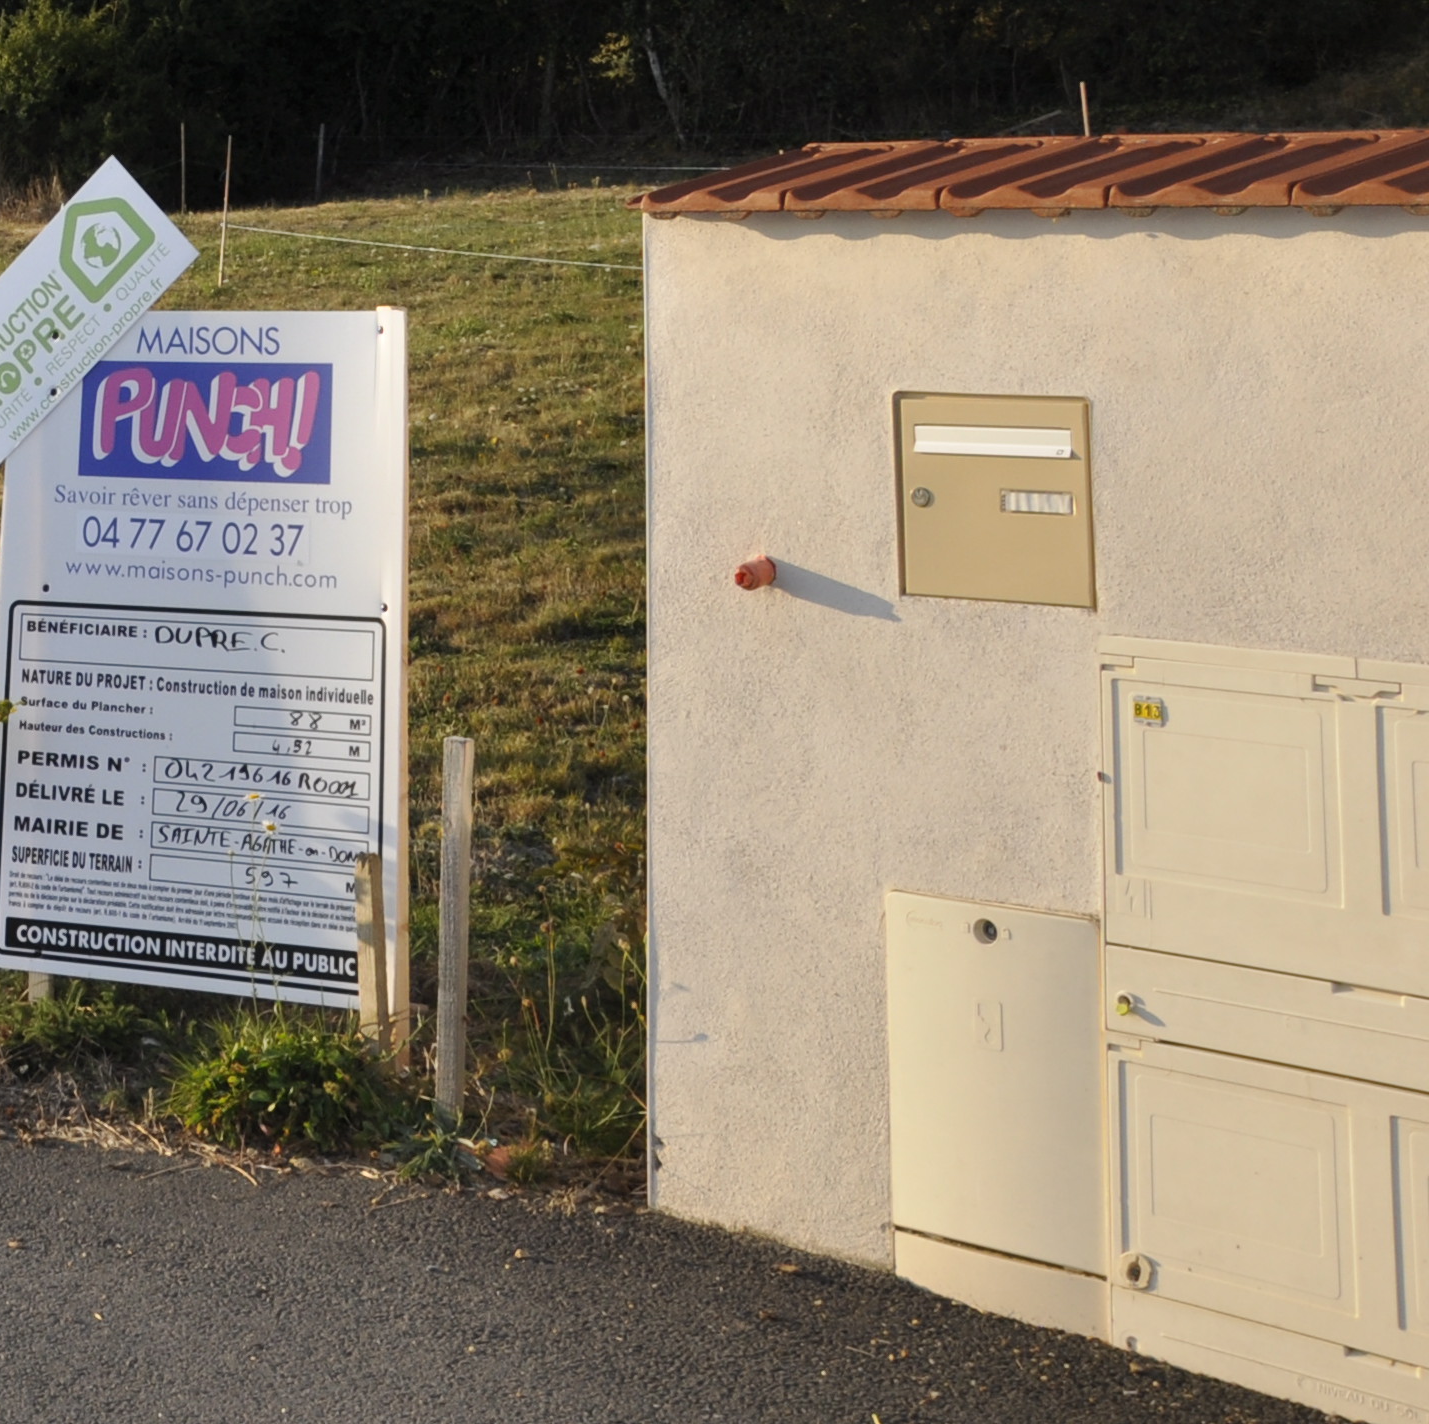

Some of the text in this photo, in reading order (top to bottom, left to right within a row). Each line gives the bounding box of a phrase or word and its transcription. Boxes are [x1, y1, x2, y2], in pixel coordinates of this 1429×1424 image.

[45, 314, 101, 376] RESPECT
[115, 242, 171, 301] QUALITÉ
[136, 327, 280, 355] MAISONS
[93, 368, 320, 478] PUNCH!
[54, 484, 353, 520] Savoir rêver sans dépenser trop
[83, 516, 304, 556] 04 77 67 02 37
[65, 560, 337, 589] www.maisons-punch.com
[21, 668, 72, 686] NATURE
[76, 672, 93, 687] DU
[97, 674, 146, 690] PROJET
[157, 676, 236, 696] Construction
[241, 682, 255, 698] de
[259, 684, 301, 700] maison
[306, 686, 373, 705] individuelle
[21, 696, 68, 709] Surface
[73, 700, 87, 710] du
[91, 701, 145, 714] Plancher
[290, 711, 322, 730] 88
[19, 720, 63, 732] Hauteur
[66, 724, 85, 734] des
[89, 726, 165, 740] Constructions
[349, 746, 360, 757] M
[17, 750, 99, 770] PERMIS
[107, 756, 130, 772] N°
[15, 779, 95, 804] DÉLIVRÉ
[102, 789, 125, 806] LE
[14, 816, 89, 837] MAIRIE
[96, 823, 123, 840] DE
[12, 846, 69, 868] SUPERFICIE
[72, 851, 86, 869] DU
[89, 853, 133, 872] TERRAIN
[16, 924, 357, 976] CONSTRUCTION INTERDITE AU PUBLIC
